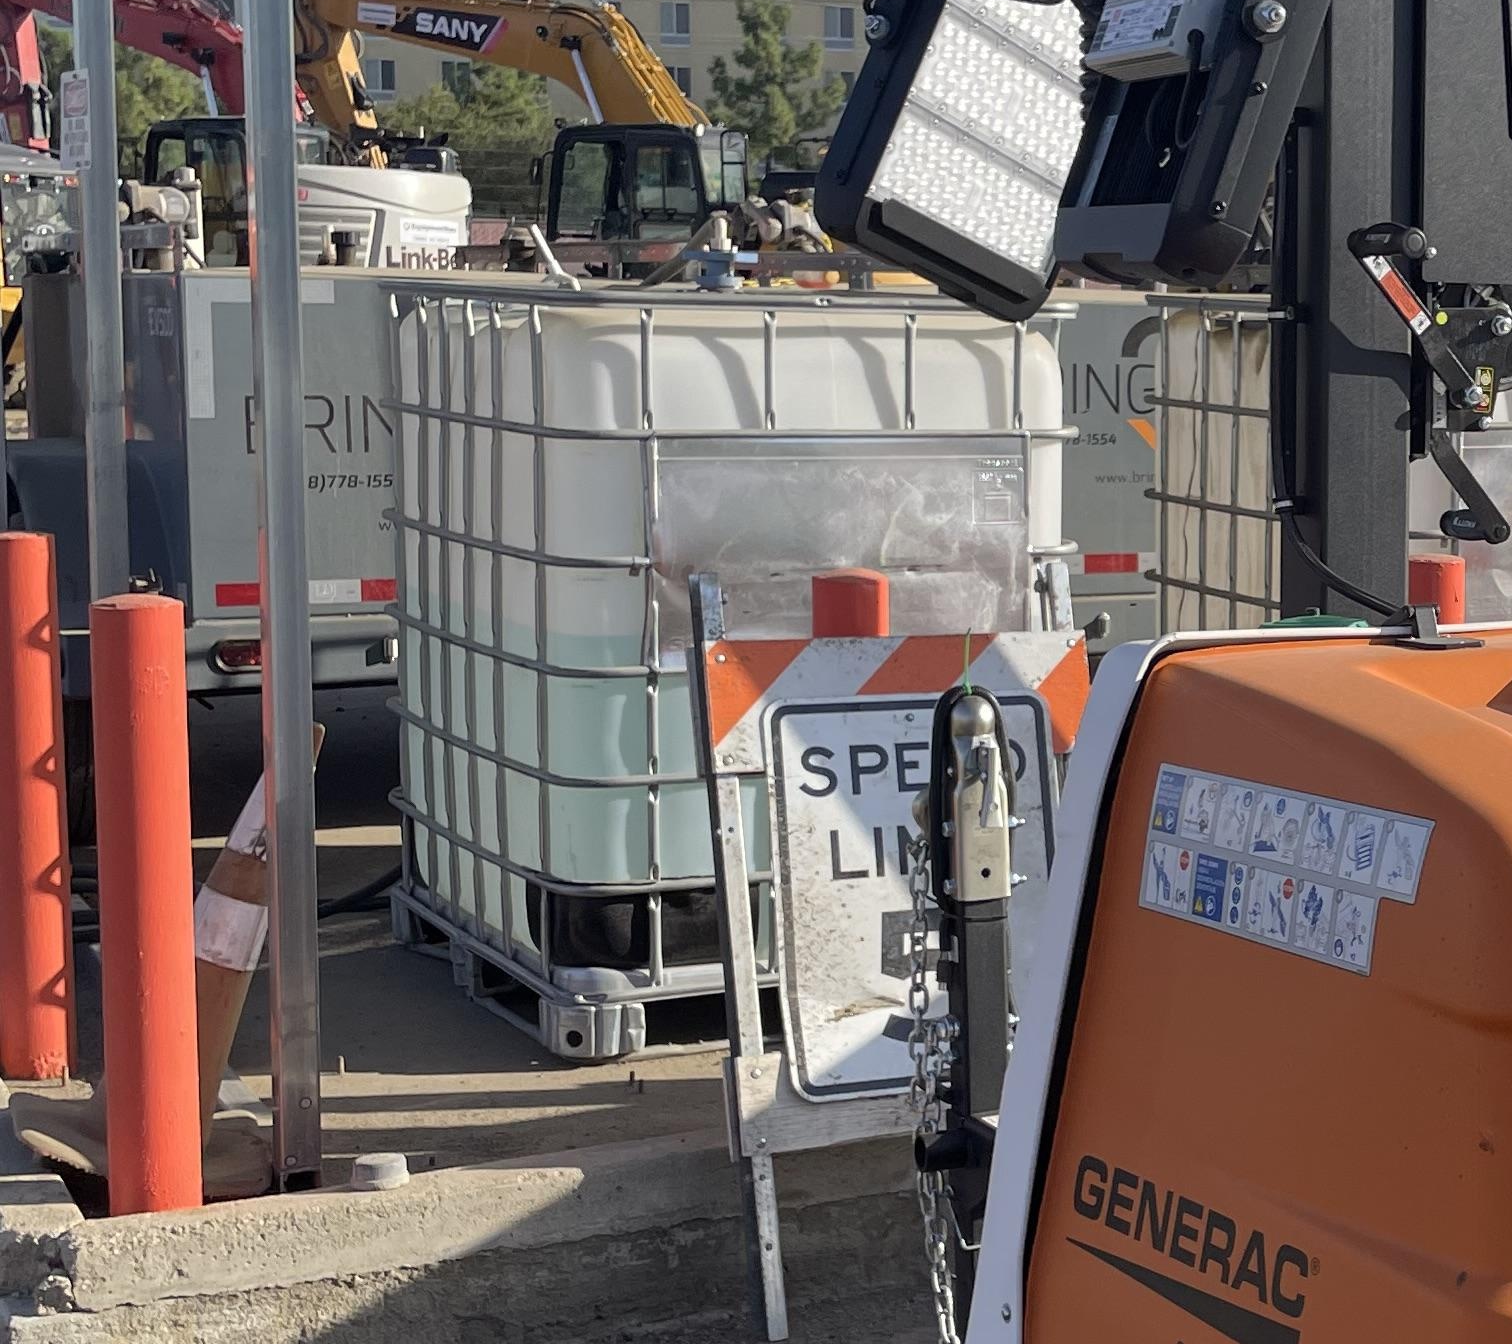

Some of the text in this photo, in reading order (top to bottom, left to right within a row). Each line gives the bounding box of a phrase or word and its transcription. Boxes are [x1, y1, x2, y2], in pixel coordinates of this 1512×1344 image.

[415, 12, 487, 44] SANY
[1061, 363, 1155, 415] ING
[245, 394, 394, 454] RIN
[799, 742, 1027, 798] SPE
[1073, 1155, 1310, 1319] GENERAC
